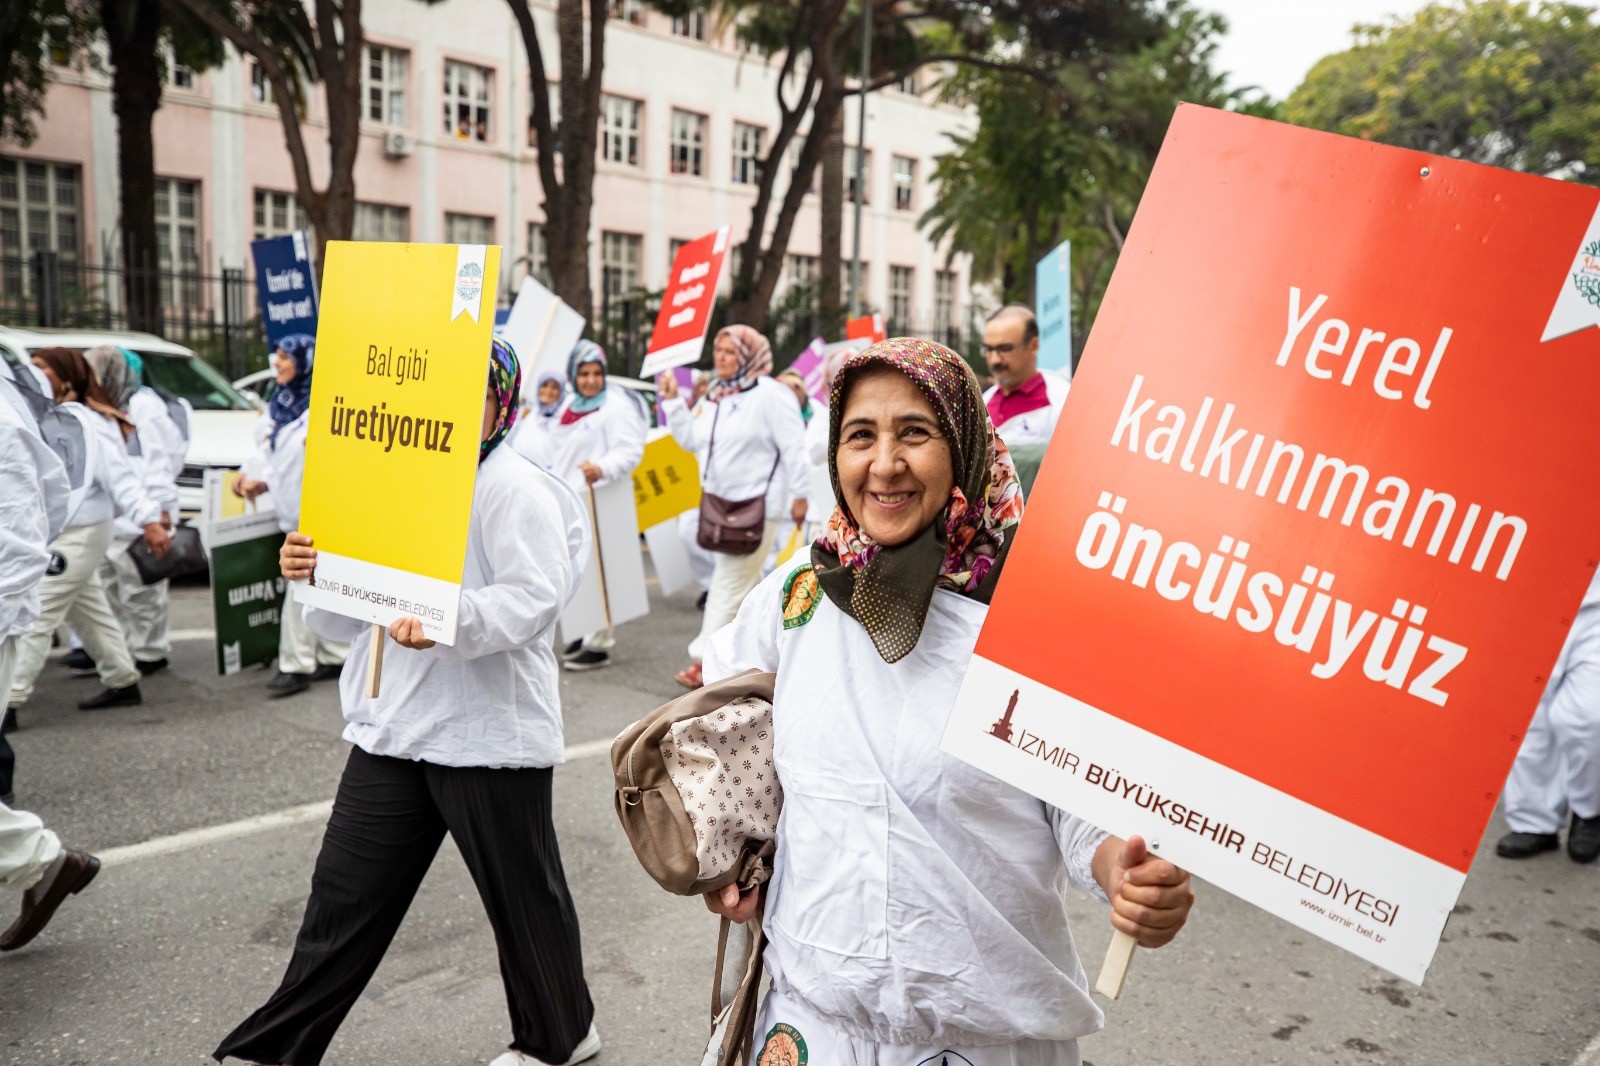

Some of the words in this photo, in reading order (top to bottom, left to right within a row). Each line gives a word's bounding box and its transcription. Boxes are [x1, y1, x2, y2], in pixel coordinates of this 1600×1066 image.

[366, 344, 393, 378] Bal
[395, 347, 428, 386] gibi
[1274, 285, 1454, 410] Yerel
[330, 395, 454, 454] üretiyoruz
[1109, 373, 1529, 582] kalkınmanın
[341, 584, 397, 609] BÜYÜKŞEHİR
[1074, 490, 1469, 708] öncüsüyüz
[1017, 728, 1080, 775] İZMİR
[1084, 763, 1246, 854] BÜYÜKŞEHİR
[1250, 841, 1401, 927] BELEDİYESİ
